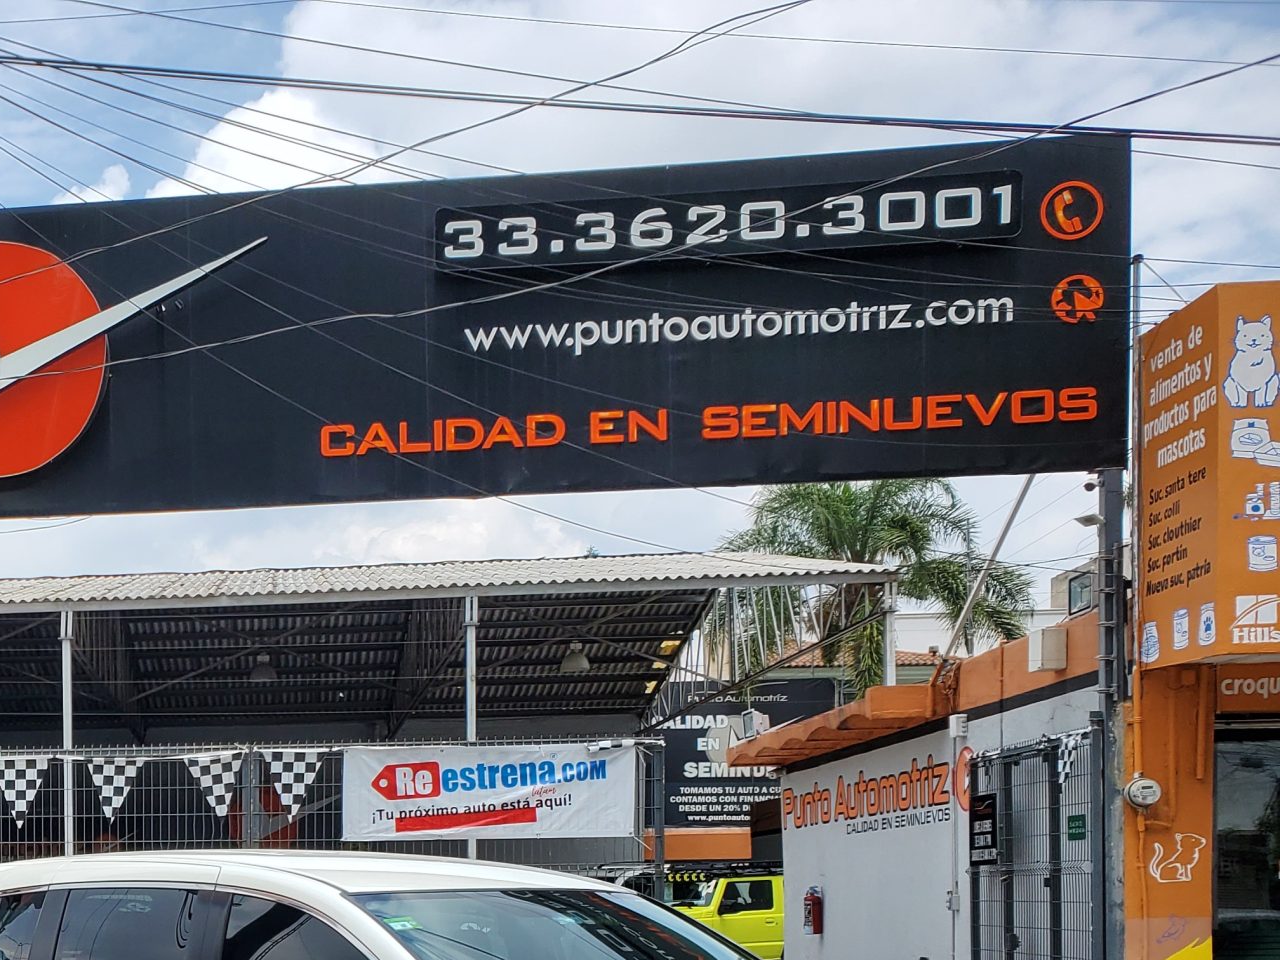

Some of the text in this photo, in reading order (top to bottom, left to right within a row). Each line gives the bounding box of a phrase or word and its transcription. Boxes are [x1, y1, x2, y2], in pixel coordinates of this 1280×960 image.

[444, 184, 1014, 260] 33.3620.3001
[463, 293, 1015, 356] www.puntoautomotriz.com
[1150, 325, 1204, 373] venta de
[1149, 352, 1213, 407] alimentos y
[318, 386, 1098, 459] CALIDAD EN SEMINUEVOS
[1143, 385, 1218, 449] productos para
[1156, 427, 1207, 469] mascotas
[1148, 466, 1207, 506] Suc. santa tere
[1148, 499, 1181, 528] Suc. colli
[1147, 517, 1203, 551] Suc. clouthier
[1145, 558, 1212, 598] Nueva suc. patria
[1146, 557, 1161, 574] Suc.
[696, 737, 720, 752] EN
[372, 793, 573, 825] ¡Tu próximo auto está aquí!
[669, 795, 718, 803] CONTAMOS
[718, 795, 738, 803] CON
[678, 804, 751, 812] DESDE UN 20% D
[680, 786, 724, 795] TOMAMOS
[724, 786, 736, 795] TU
[737, 786, 760, 795] AUTO
[761, 786, 768, 795] A
[782, 753, 951, 831] Punto Automotriz
[687, 814, 751, 823] www.puntoauto
[845, 807, 951, 835] CALIDAD EN SEMINUEVOS
